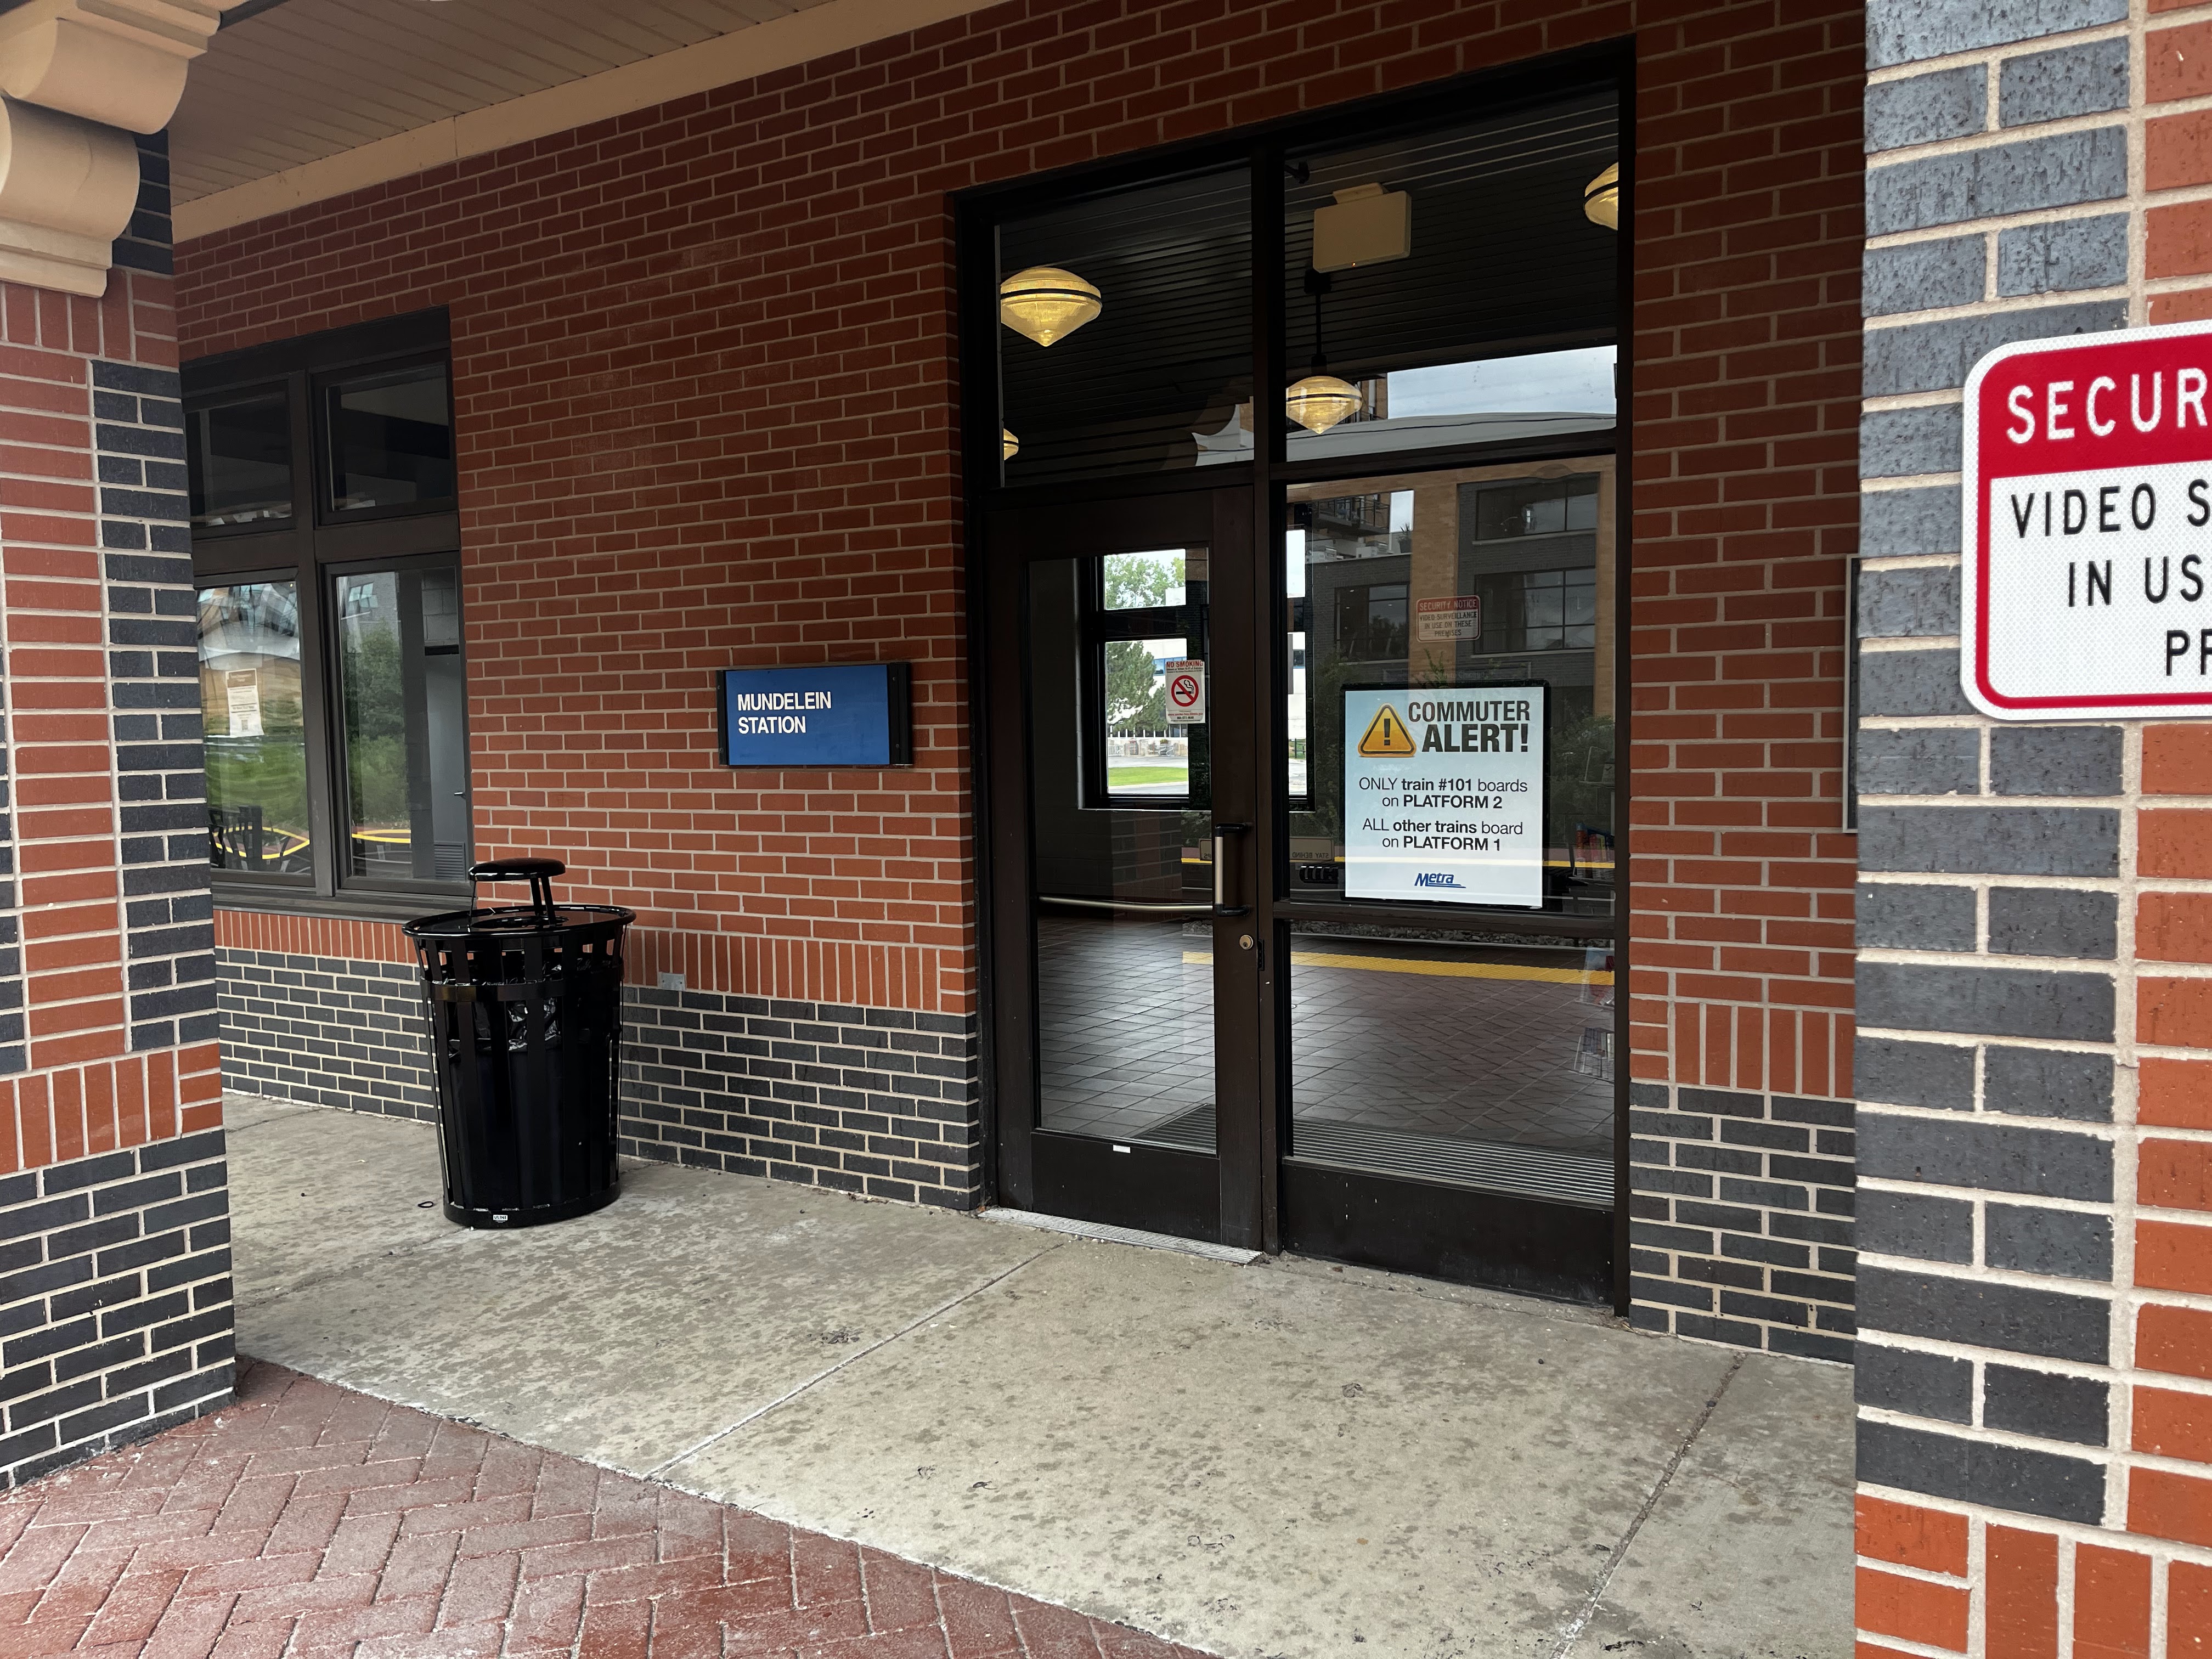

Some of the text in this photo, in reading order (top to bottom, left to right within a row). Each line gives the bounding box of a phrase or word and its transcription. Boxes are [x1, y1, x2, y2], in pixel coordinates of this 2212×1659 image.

[2006, 368, 2208, 444] SECUR
[2011, 478, 2211, 538] VIDEO S
[2068, 554, 2204, 607] IN US
[1419, 599, 1477, 611] SECURITY NOTICE
[1437, 611, 1477, 620] SURVEILLANCE
[737, 691, 832, 711] MUNDELEIN
[1408, 700, 1530, 722] COMMUTER
[738, 715, 806, 734] STATION
[1422, 723, 1528, 752] ALERT!
[1359, 777, 1528, 792] ONLY train #101 boards
[1382, 795, 1503, 809] on PLATFORM 2
[1362, 818, 1523, 834] ALL other trains board
[1382, 836, 1500, 851] on PLATFORM 1
[1414, 872, 1456, 888] Metra
